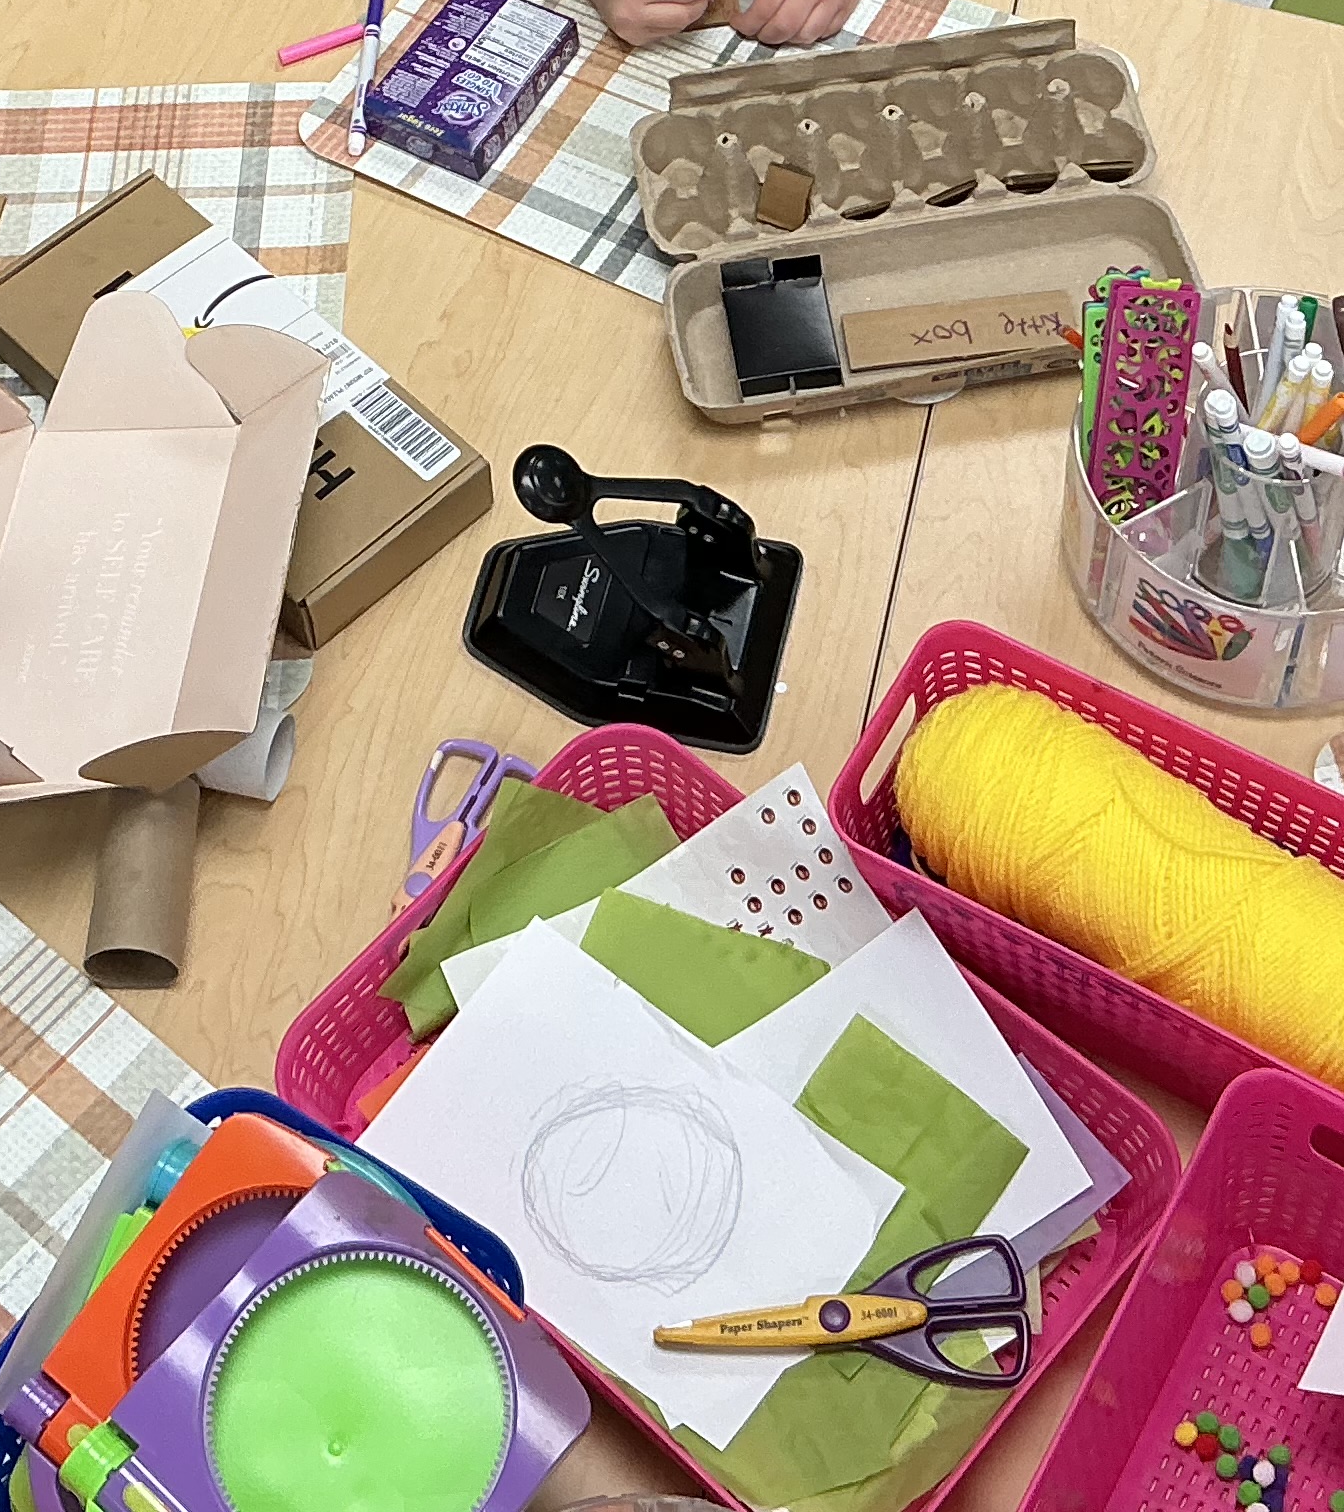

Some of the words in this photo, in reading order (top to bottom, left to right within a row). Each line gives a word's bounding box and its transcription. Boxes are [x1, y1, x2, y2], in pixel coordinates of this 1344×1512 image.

[455, 76, 491, 96] SINGLES
[908, 313, 974, 353] box
[720, 1323, 752, 1337] Paper
[756, 1317, 803, 1332] Shapers
